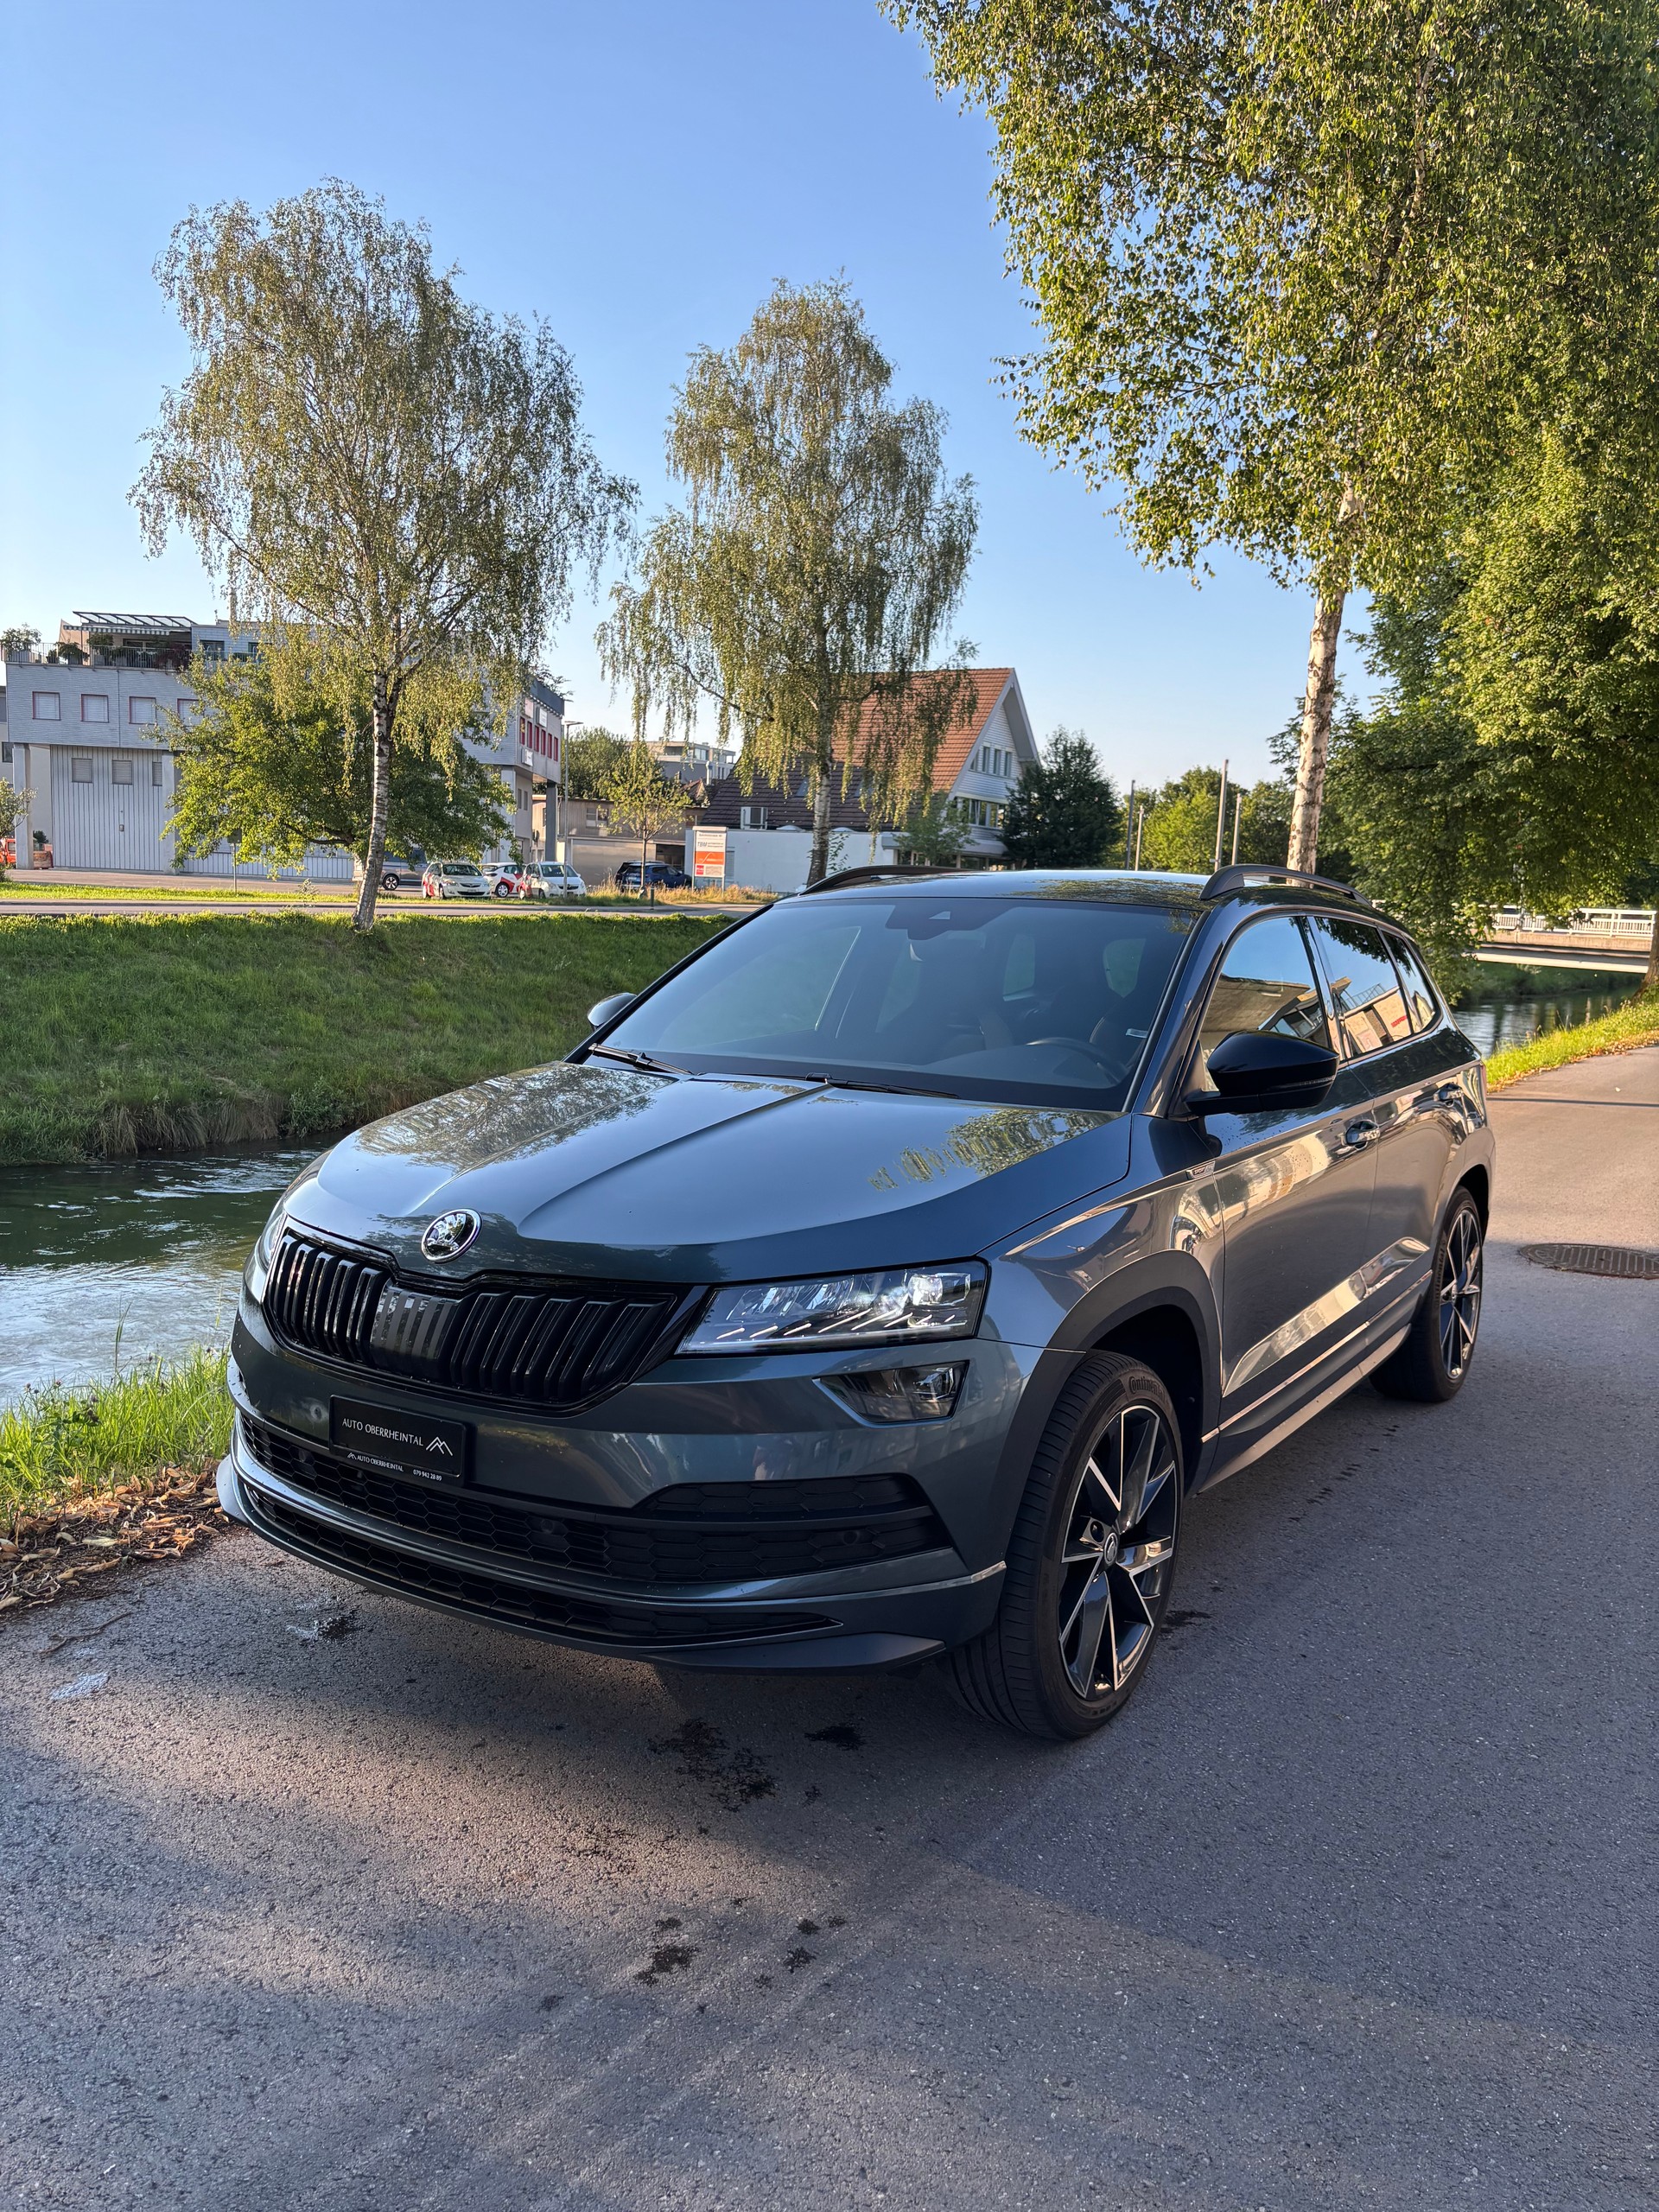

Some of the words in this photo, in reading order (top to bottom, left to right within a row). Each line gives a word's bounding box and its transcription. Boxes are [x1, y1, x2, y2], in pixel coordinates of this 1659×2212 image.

[1128, 1376, 1166, 1405] Continental
[342, 1418, 363, 1431] AUTO
[365, 1424, 423, 1446] OBERRHEINTAL
[371, 1459, 404, 1471] OBERRHEINTAL
